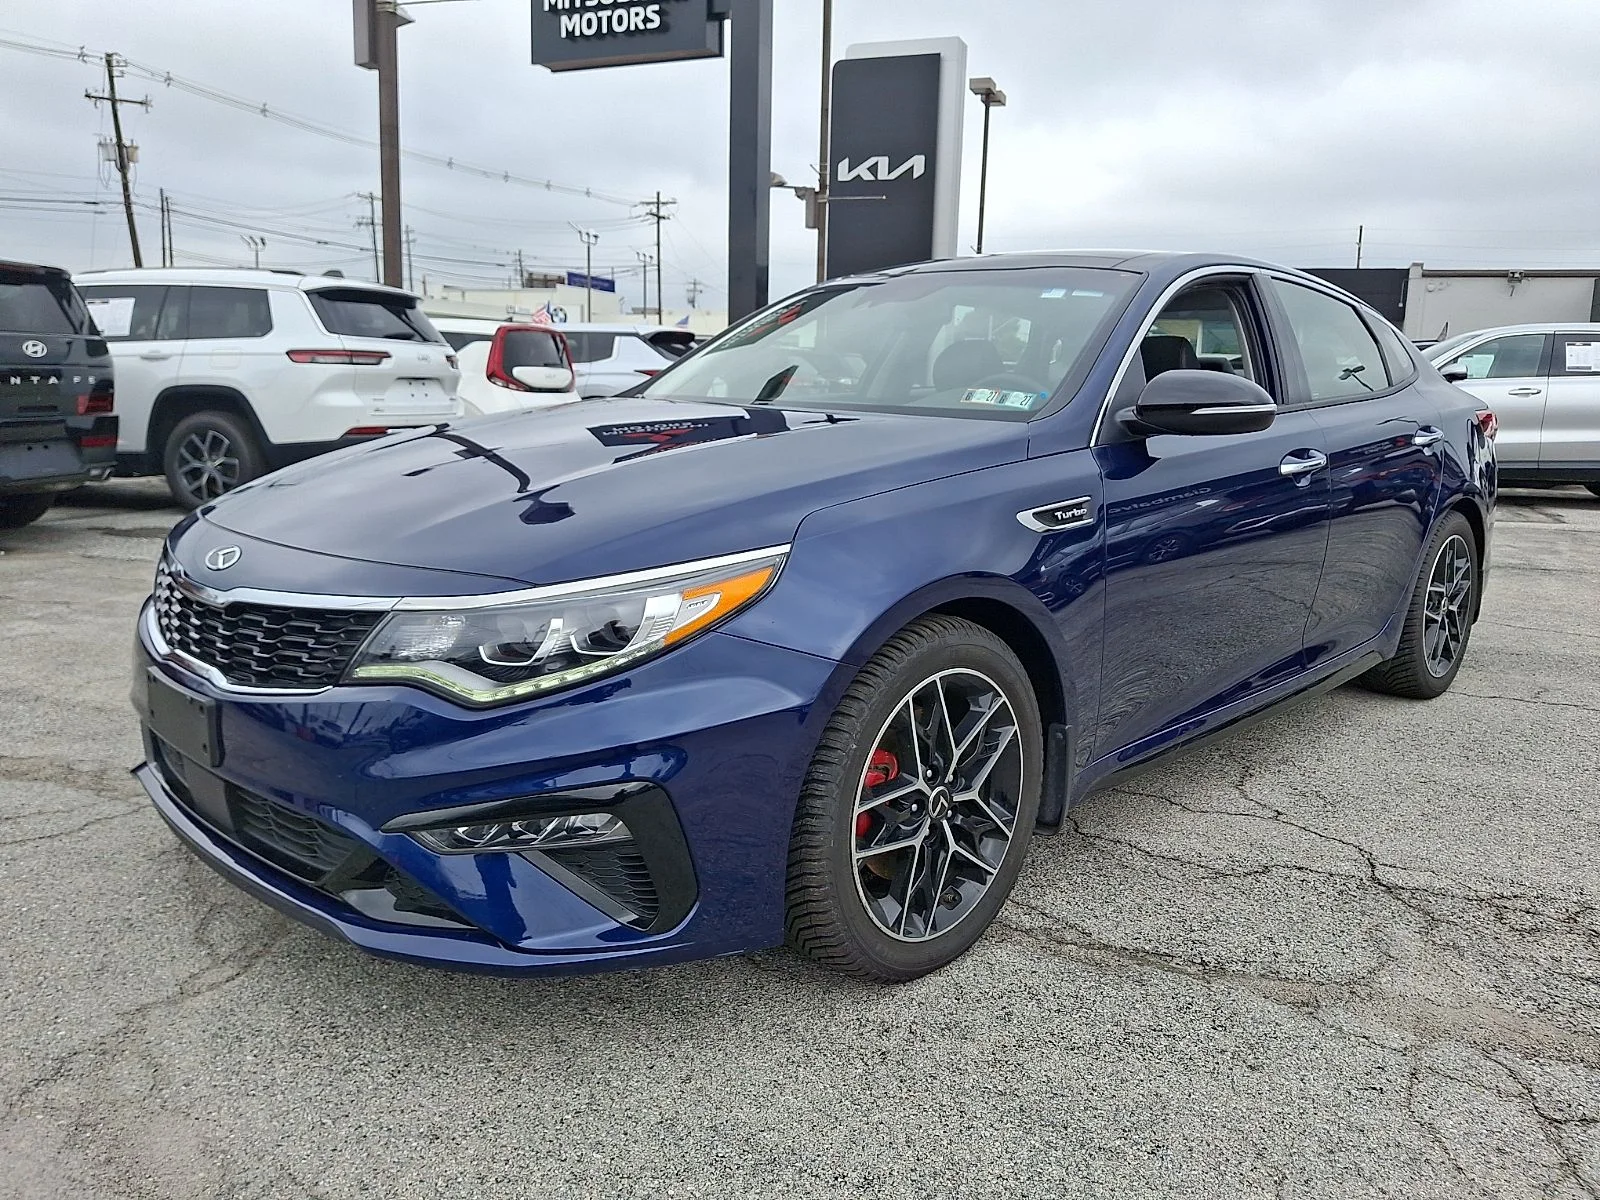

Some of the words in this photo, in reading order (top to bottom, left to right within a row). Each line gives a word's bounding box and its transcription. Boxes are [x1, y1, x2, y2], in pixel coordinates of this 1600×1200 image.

[560, 4, 661, 38] MOTORS
[837, 154, 926, 182] KIA
[0, 376, 59, 385] NTA
[986, 391, 997, 402] 27
[1019, 395, 1032, 406] 27
[1054, 508, 1088, 521] Turbo
